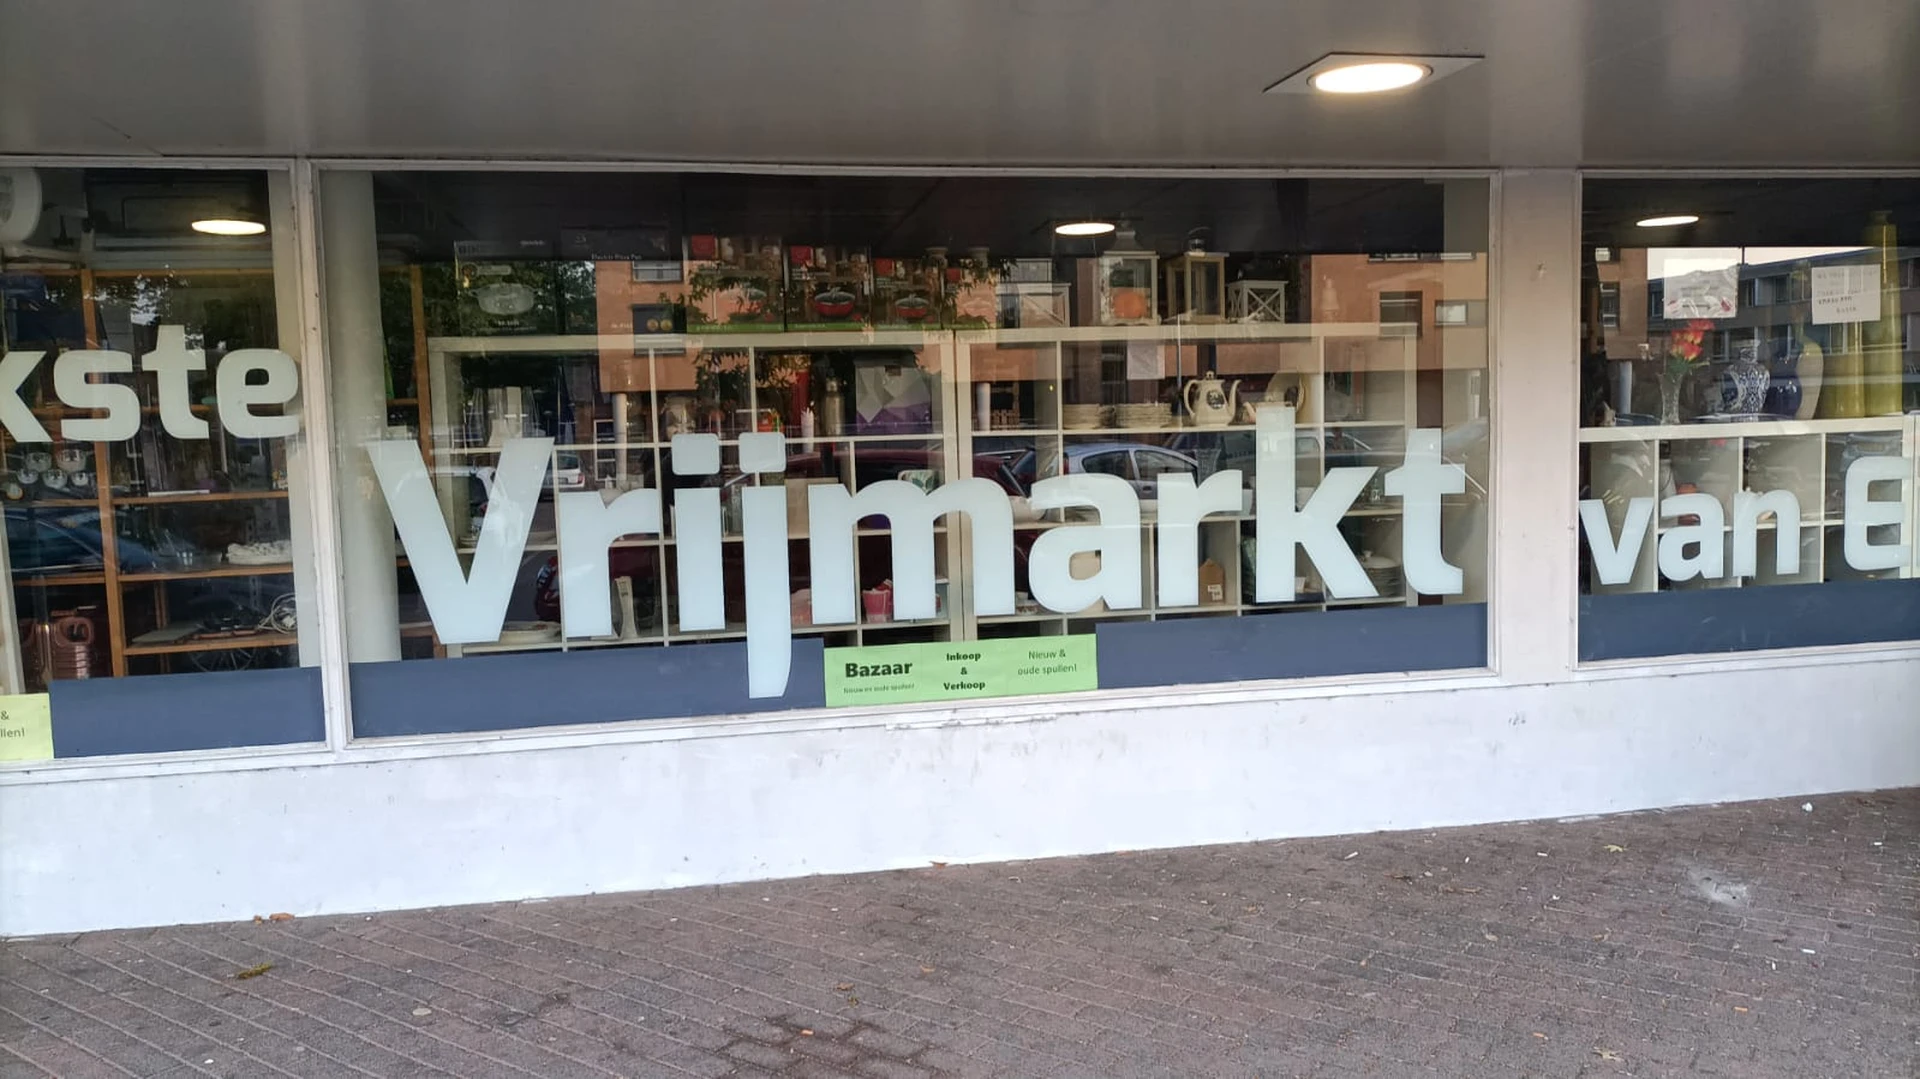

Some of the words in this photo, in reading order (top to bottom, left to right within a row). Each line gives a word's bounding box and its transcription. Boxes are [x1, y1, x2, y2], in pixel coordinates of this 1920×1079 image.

[1580, 488, 1800, 586] van
[1844, 456, 1920, 571] E
[365, 406, 1466, 699] Vrijmarkt
[946, 652, 981, 661] Inkoop
[1028, 650, 1057, 660] Nieuw
[1058, 648, 1066, 658] &
[845, 662, 913, 678] Bazaar
[960, 666, 968, 675] &
[1017, 665, 1040, 675] oude
[1041, 663, 1077, 675] spullen!
[943, 681, 986, 691] Verkoop
[0, 710, 9, 721] &
